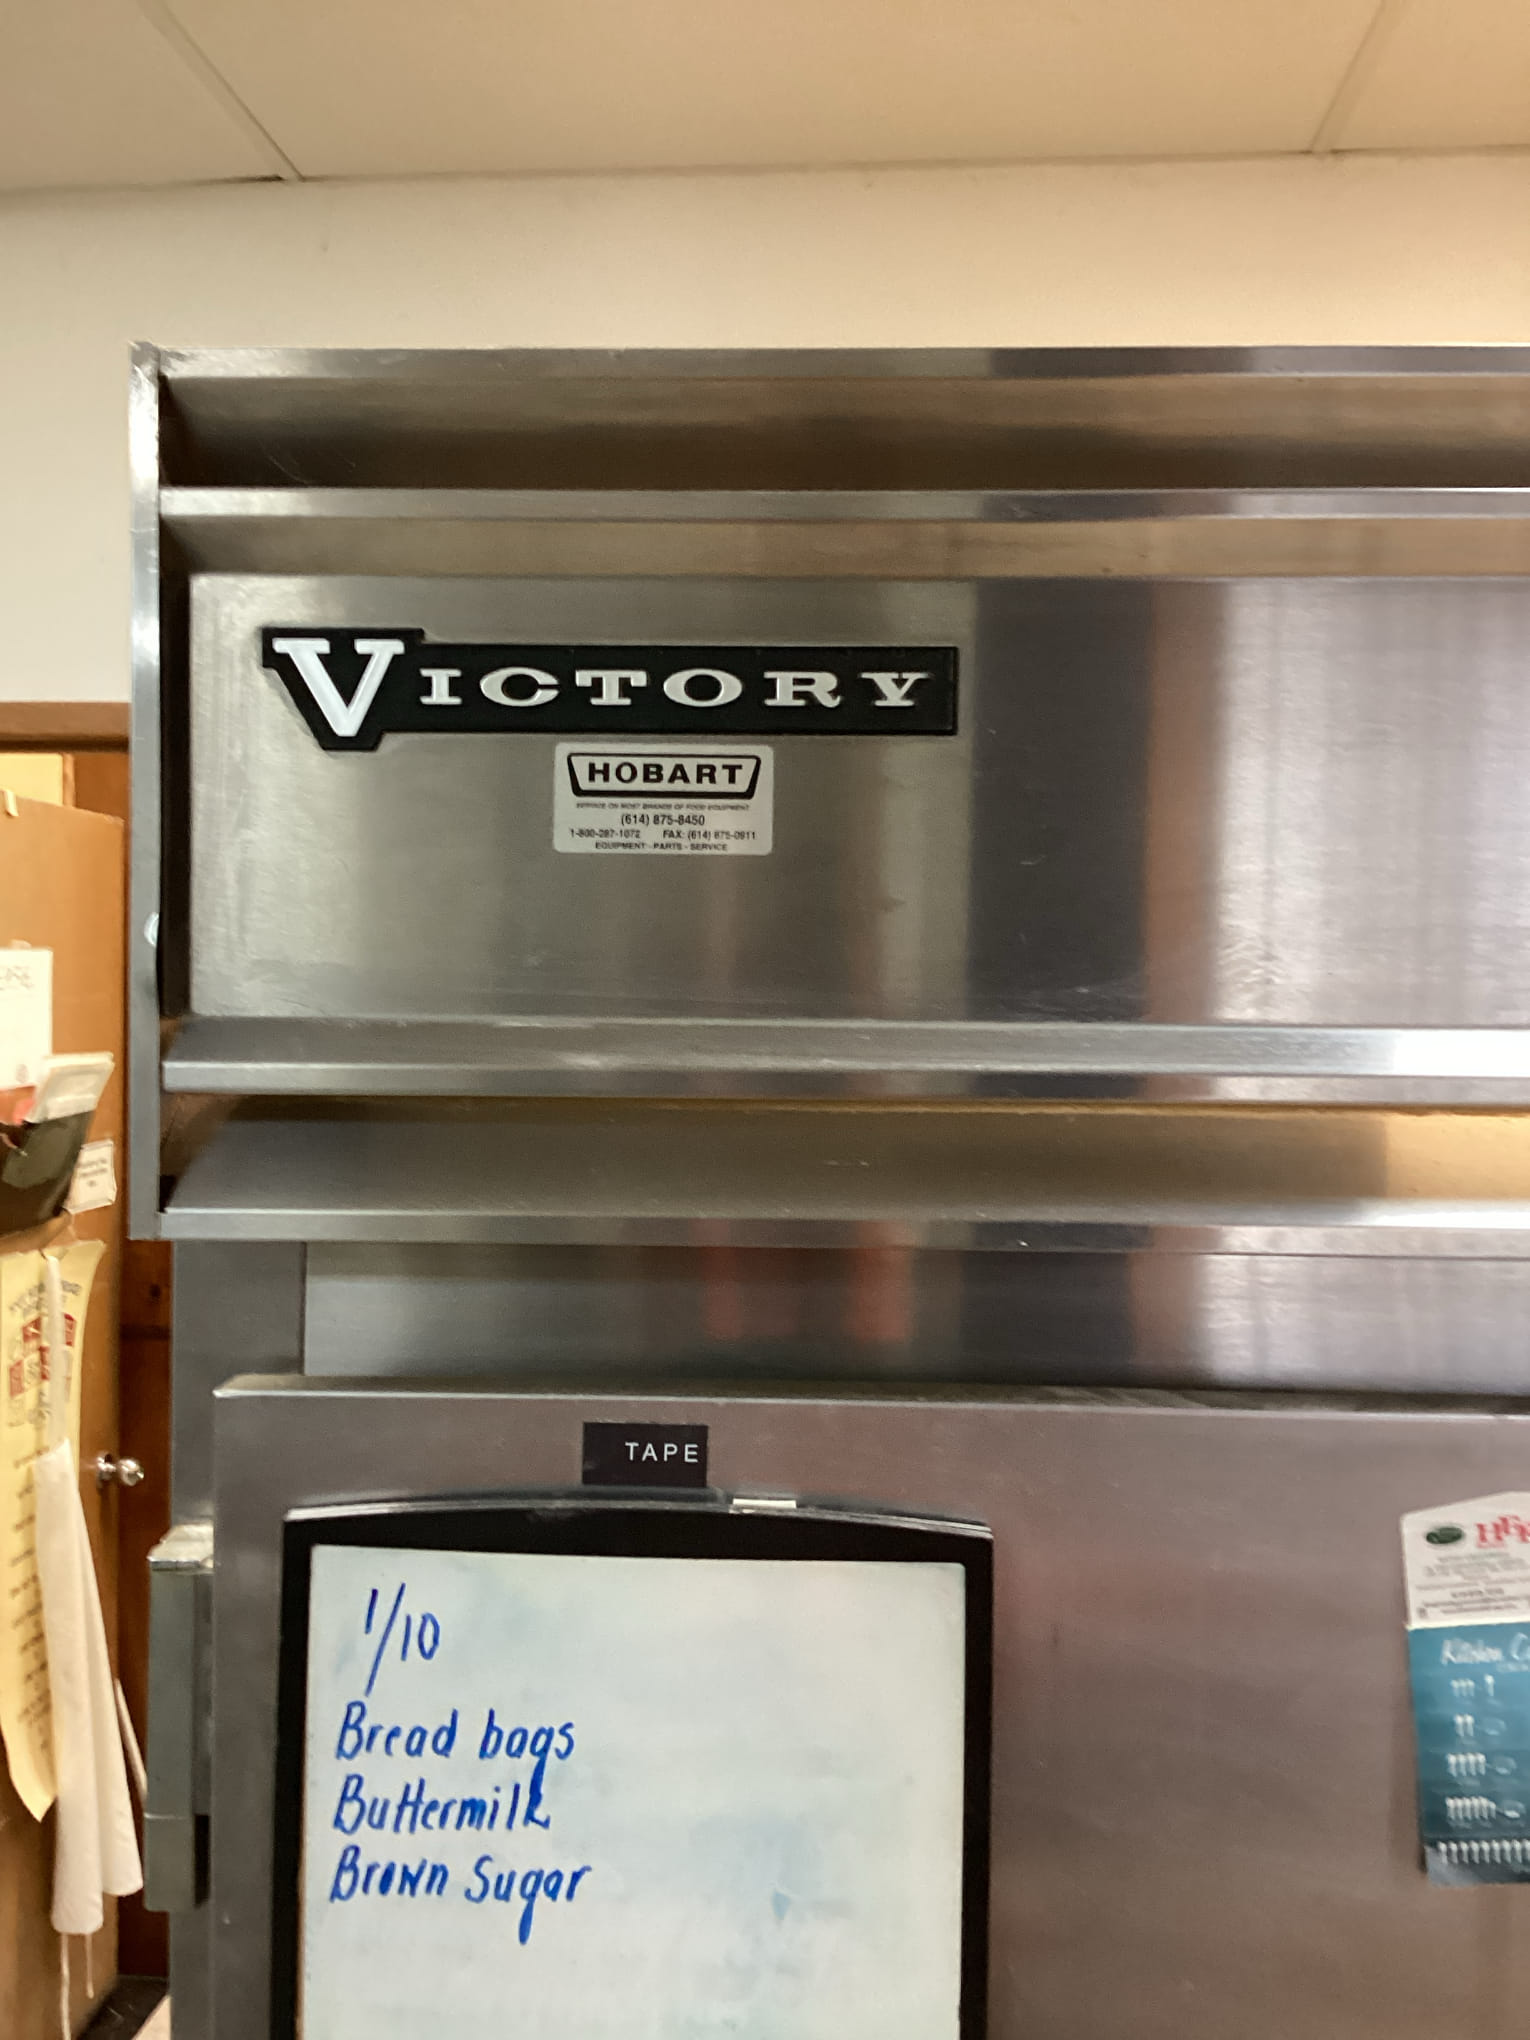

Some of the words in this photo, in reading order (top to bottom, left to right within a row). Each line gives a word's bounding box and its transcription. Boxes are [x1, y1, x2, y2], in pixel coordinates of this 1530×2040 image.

[273, 637, 934, 737] VICTORY
[588, 762, 743, 785] HOBART
[621, 813, 650, 827] (614)
[653, 814, 705, 826] 875-8450
[687, 829, 712, 841] (614)
[595, 841, 645, 850] EQUIPMENT
[653, 842, 683, 851] PARTS
[690, 843, 728, 852] SERVICE
[625, 1442, 699, 1463] TAPE
[364, 1582, 442, 1697] 1/10
[335, 1700, 459, 1760] Bread
[478, 1708, 576, 1789] bags
[332, 1772, 551, 1835] Buttermilk
[328, 1844, 450, 1903] Brown
[463, 1854, 593, 1945] Sugar
